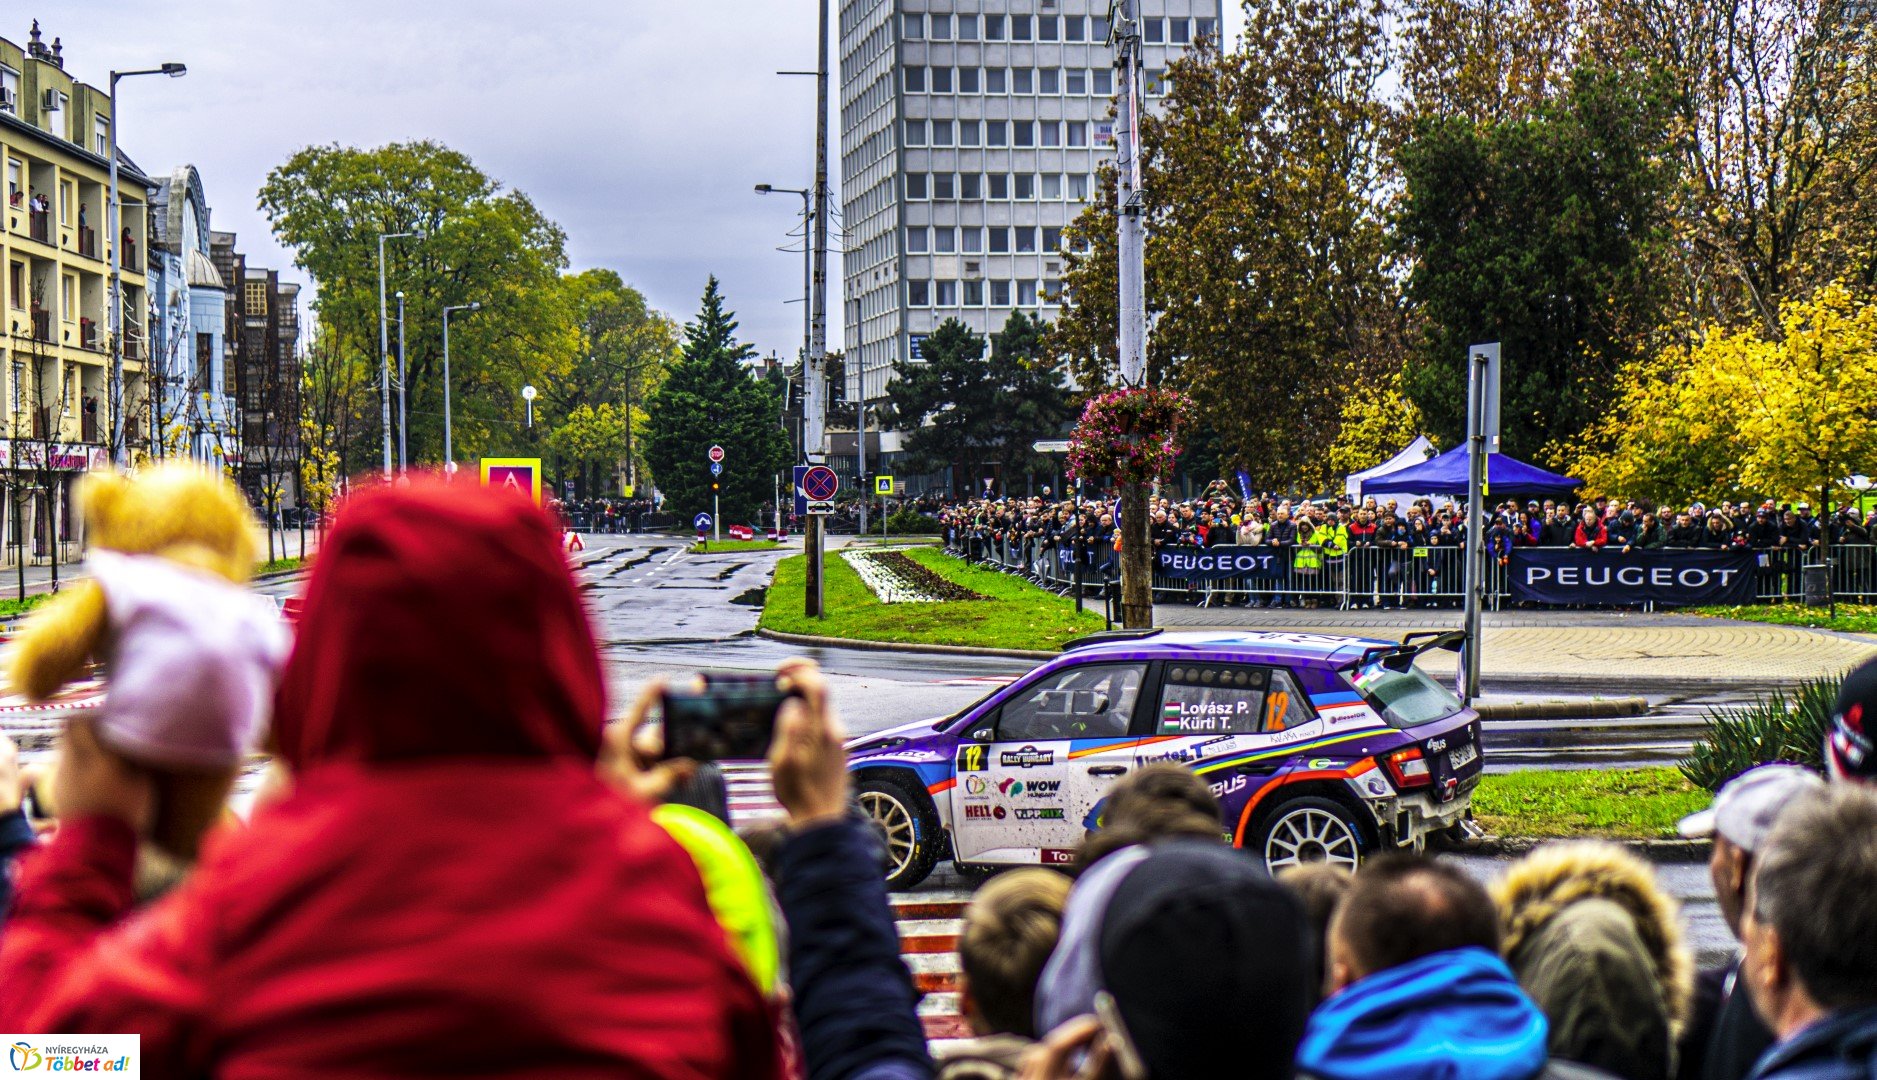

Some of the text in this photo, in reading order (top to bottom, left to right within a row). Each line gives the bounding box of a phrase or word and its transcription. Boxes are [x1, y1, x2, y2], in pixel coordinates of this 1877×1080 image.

[1161, 554, 1274, 570] PEUGEOT
[1526, 566, 1738, 587] PEUGEOT
[1180, 701, 1249, 715] Lovász P.
[1266, 691, 1290, 731] 12
[1179, 717, 1231, 730] Kürti T.
[965, 745, 982, 771] 12
[1002, 753, 1052, 763] RALLY HUNGARY
[1026, 780, 1061, 791] WOW
[1208, 774, 1247, 798] BUS
[965, 805, 991, 818] HELL
